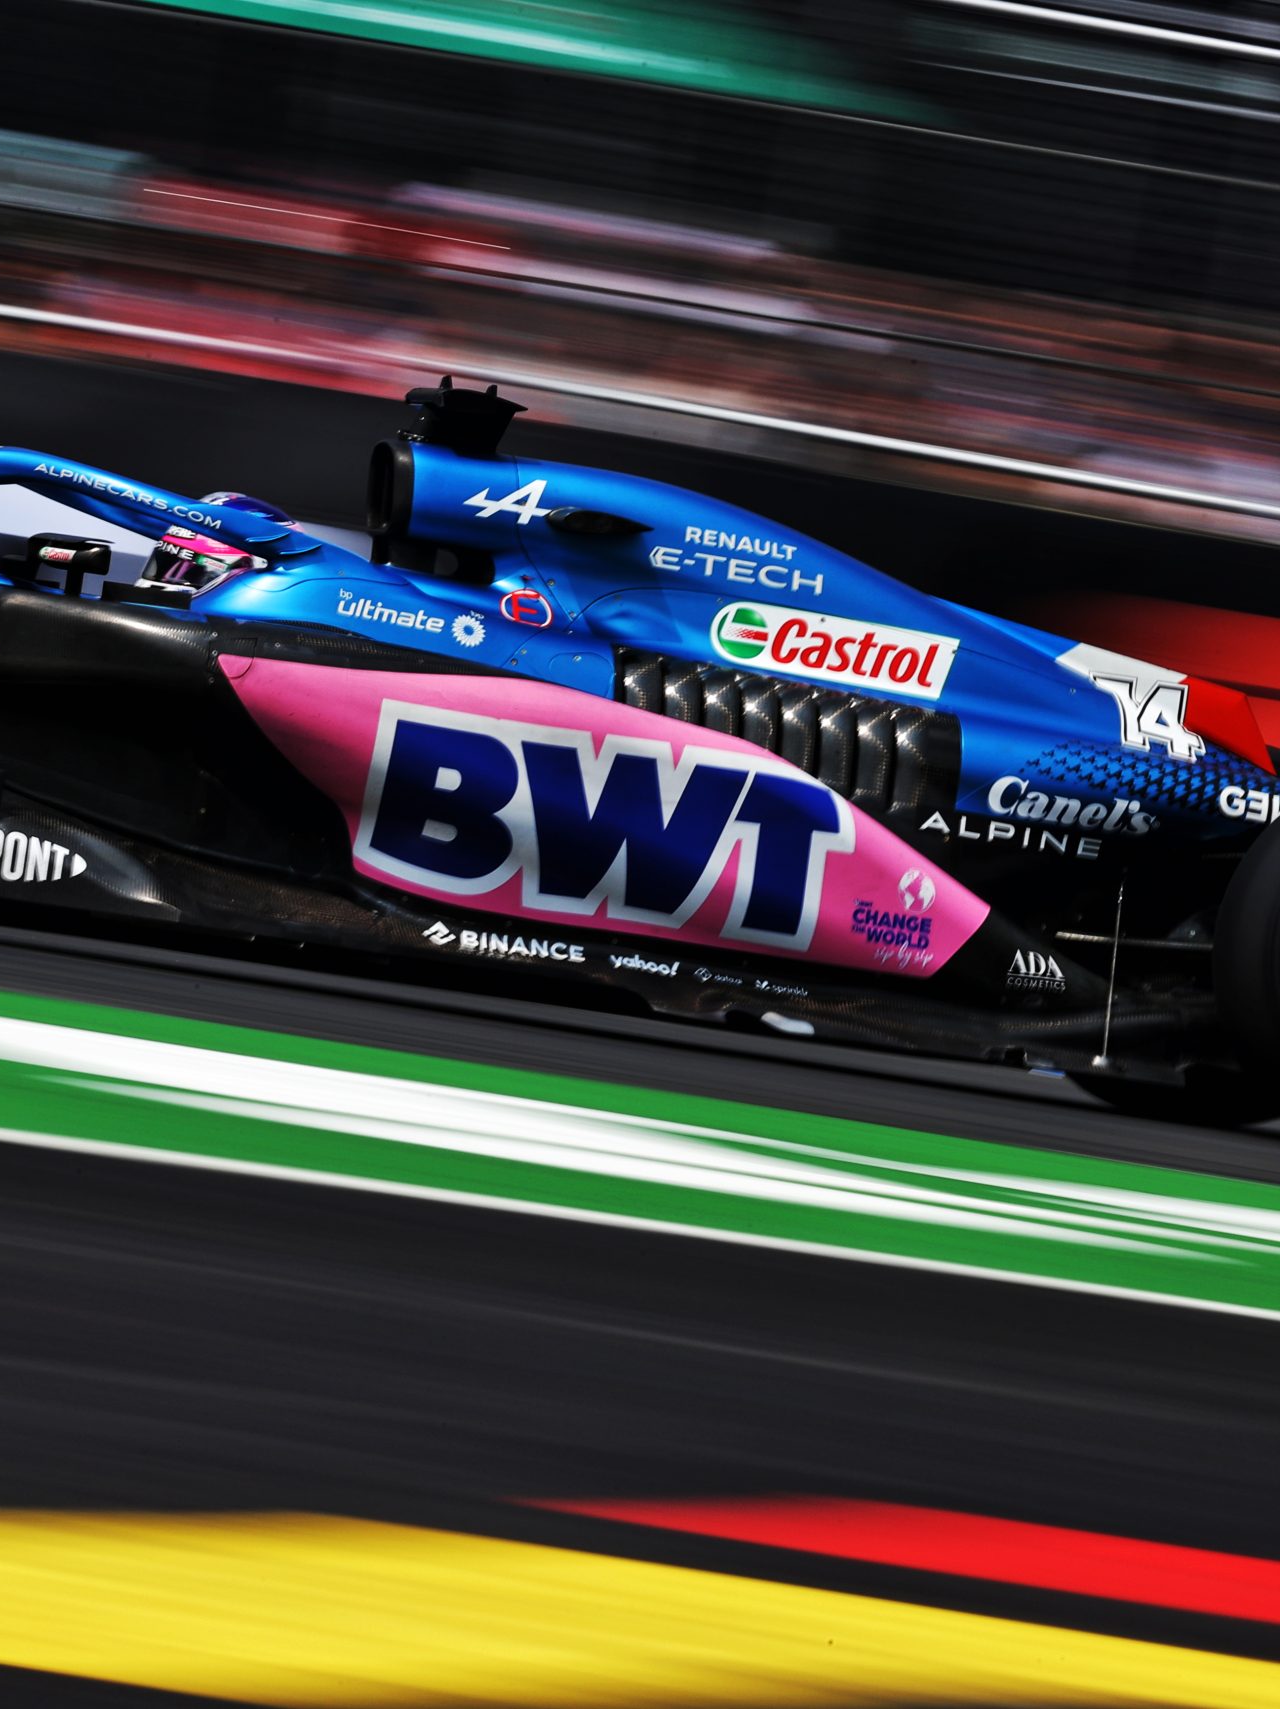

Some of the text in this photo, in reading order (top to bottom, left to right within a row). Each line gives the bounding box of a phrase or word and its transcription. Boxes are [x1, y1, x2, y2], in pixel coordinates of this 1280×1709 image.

[33, 463, 222, 530] ALPINECARS.COM
[685, 526, 797, 561] RENAULT
[339, 588, 353, 600] bp
[337, 598, 445, 633] ultimate
[771, 618, 939, 687] Castrol
[987, 775, 1157, 837] Canel's
[357, 701, 853, 949] BWT
[920, 810, 1102, 860] ALPINE
[852, 908, 932, 934] CHANGE
[459, 929, 586, 962] BINANCE
[866, 927, 930, 950] WORLD
[610, 953, 680, 977] yahoo!
[1007, 948, 1065, 978] ADA
[1007, 976, 1066, 992] COSMETICS
